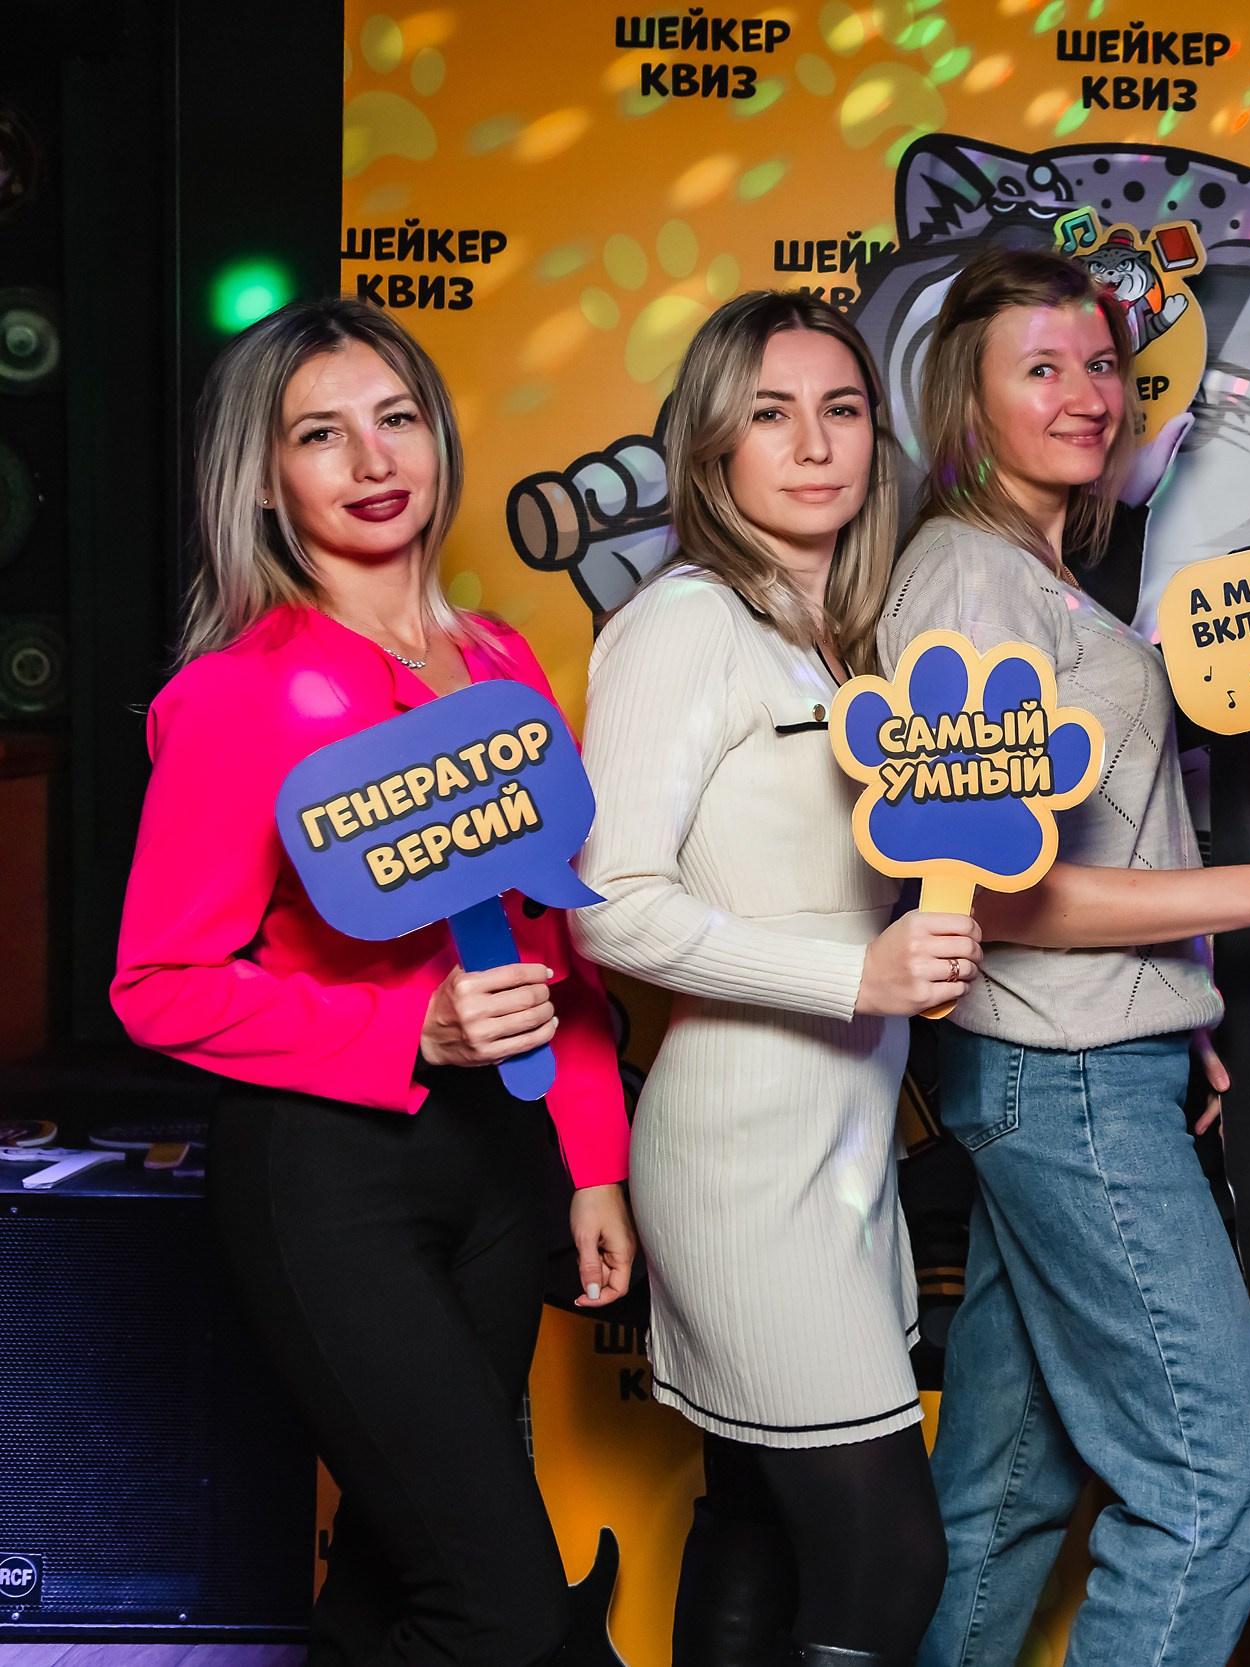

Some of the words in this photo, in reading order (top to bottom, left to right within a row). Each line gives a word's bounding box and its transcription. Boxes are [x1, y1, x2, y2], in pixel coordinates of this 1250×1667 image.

[615, 7, 791, 53] ШЕЙКЕР
[1057, 21, 1230, 66] ШЕЙКЕР
[641, 63, 757, 98] КВИЗ
[1082, 76, 1197, 111] КВИЗ
[341, 218, 507, 264] ШЕЙКЕР
[357, 274, 473, 310] КВИЗ
[1190, 588, 1212, 615] А
[877, 699, 1047, 756] САМЫЙ
[298, 720, 551, 851] ГЕНЕРАТОР
[880, 747, 1053, 804] УМНЫЙ
[363, 782, 541, 890] ВЕРСИЙ
[0, 1568, 33, 1586] RCF
